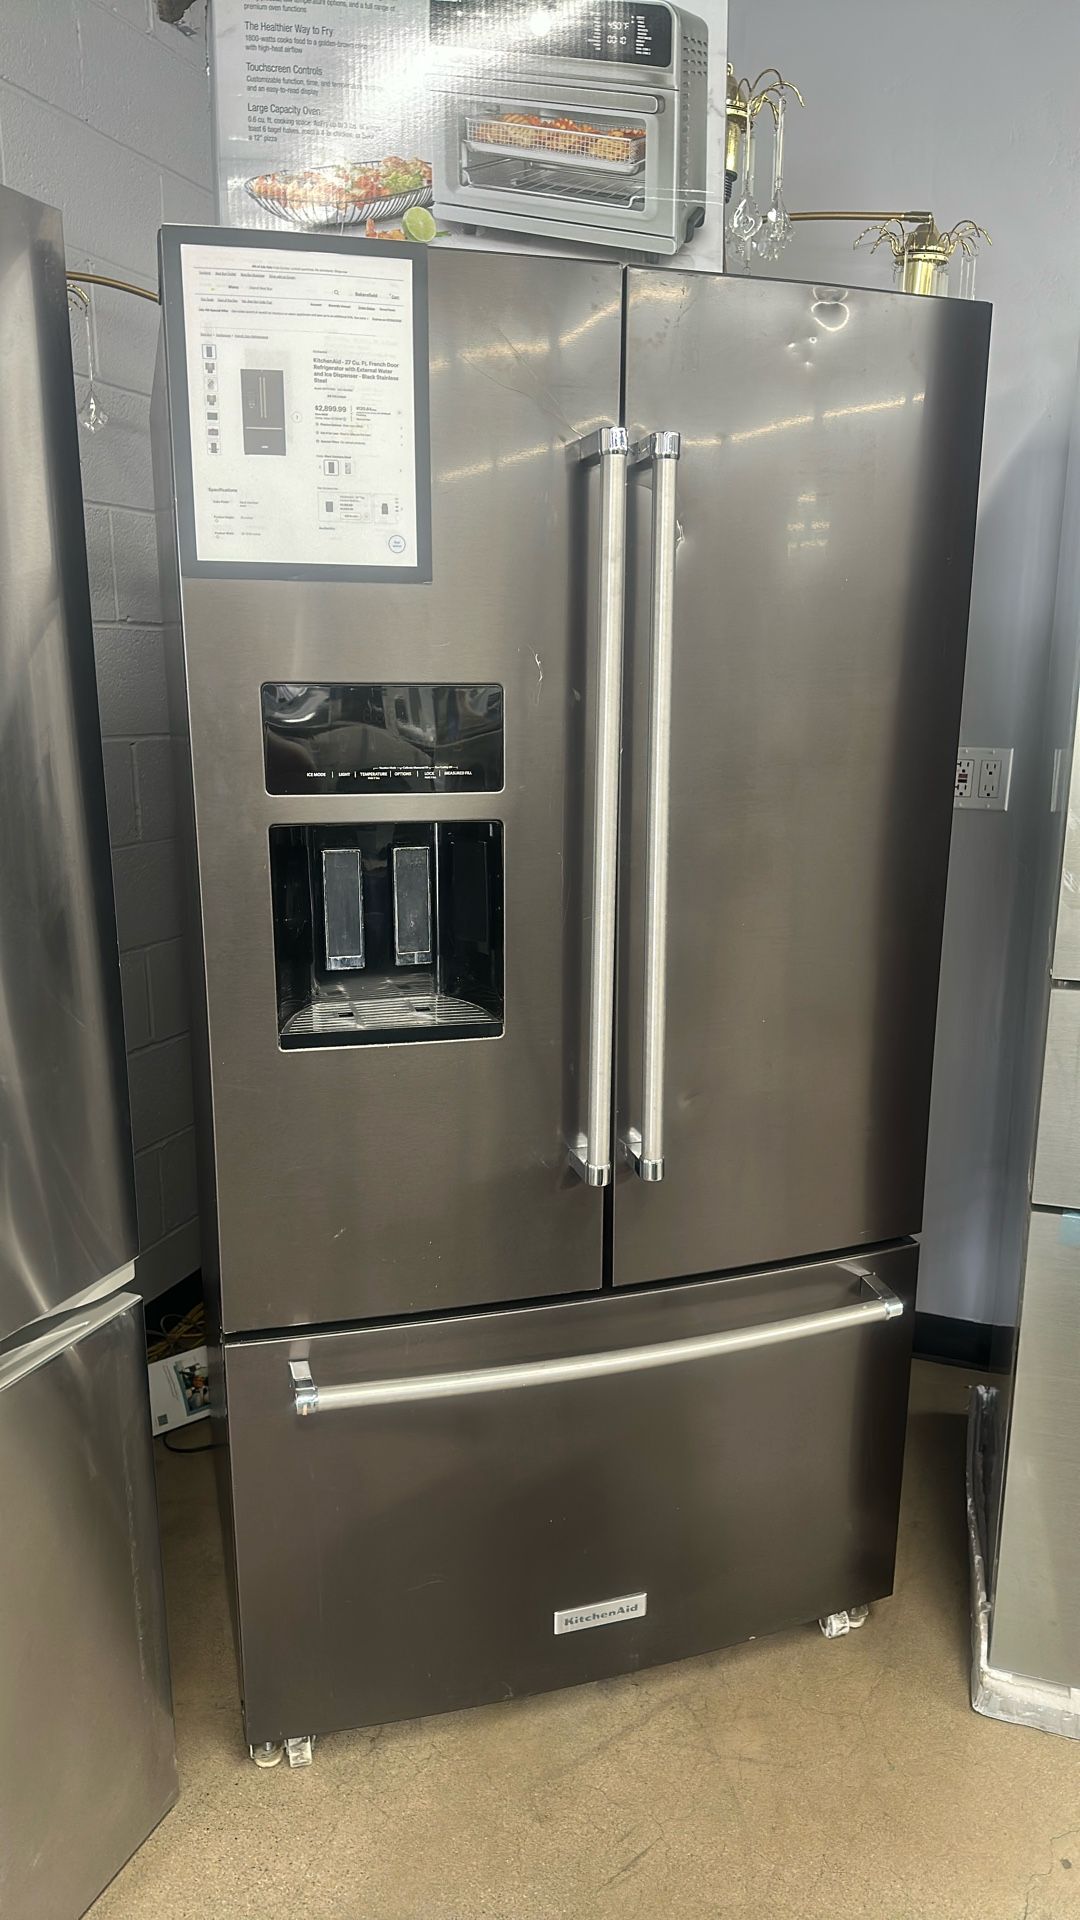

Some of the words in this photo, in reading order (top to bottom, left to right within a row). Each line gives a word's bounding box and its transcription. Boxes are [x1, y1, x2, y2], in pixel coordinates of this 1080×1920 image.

[244, 3, 268, 11] premium
[282, 4, 307, 13] functions
[244, 20, 259, 31] The
[260, 22, 292, 33] Healthier
[295, 24, 310, 36] Way
[312, 26, 320, 35] to
[321, 26, 334, 38] Fry
[245, 34, 276, 43] 1800-watts
[258, 44, 284, 53] high-heat
[284, 46, 302, 54] airflow
[246, 62, 292, 74] Touchscreen
[292, 64, 323, 76] Controls
[246, 75, 282, 84] Customizable
[266, 86, 300, 95] easy-to-read
[300, 87, 318, 96] display
[248, 102, 268, 114] Large
[270, 104, 302, 116] Capacity
[302, 106, 321, 116] Oven
[274, 118, 294, 126] cooking
[267, 126, 282, 134] bagel
[564, 1604, 639, 1626] KitchenAid
